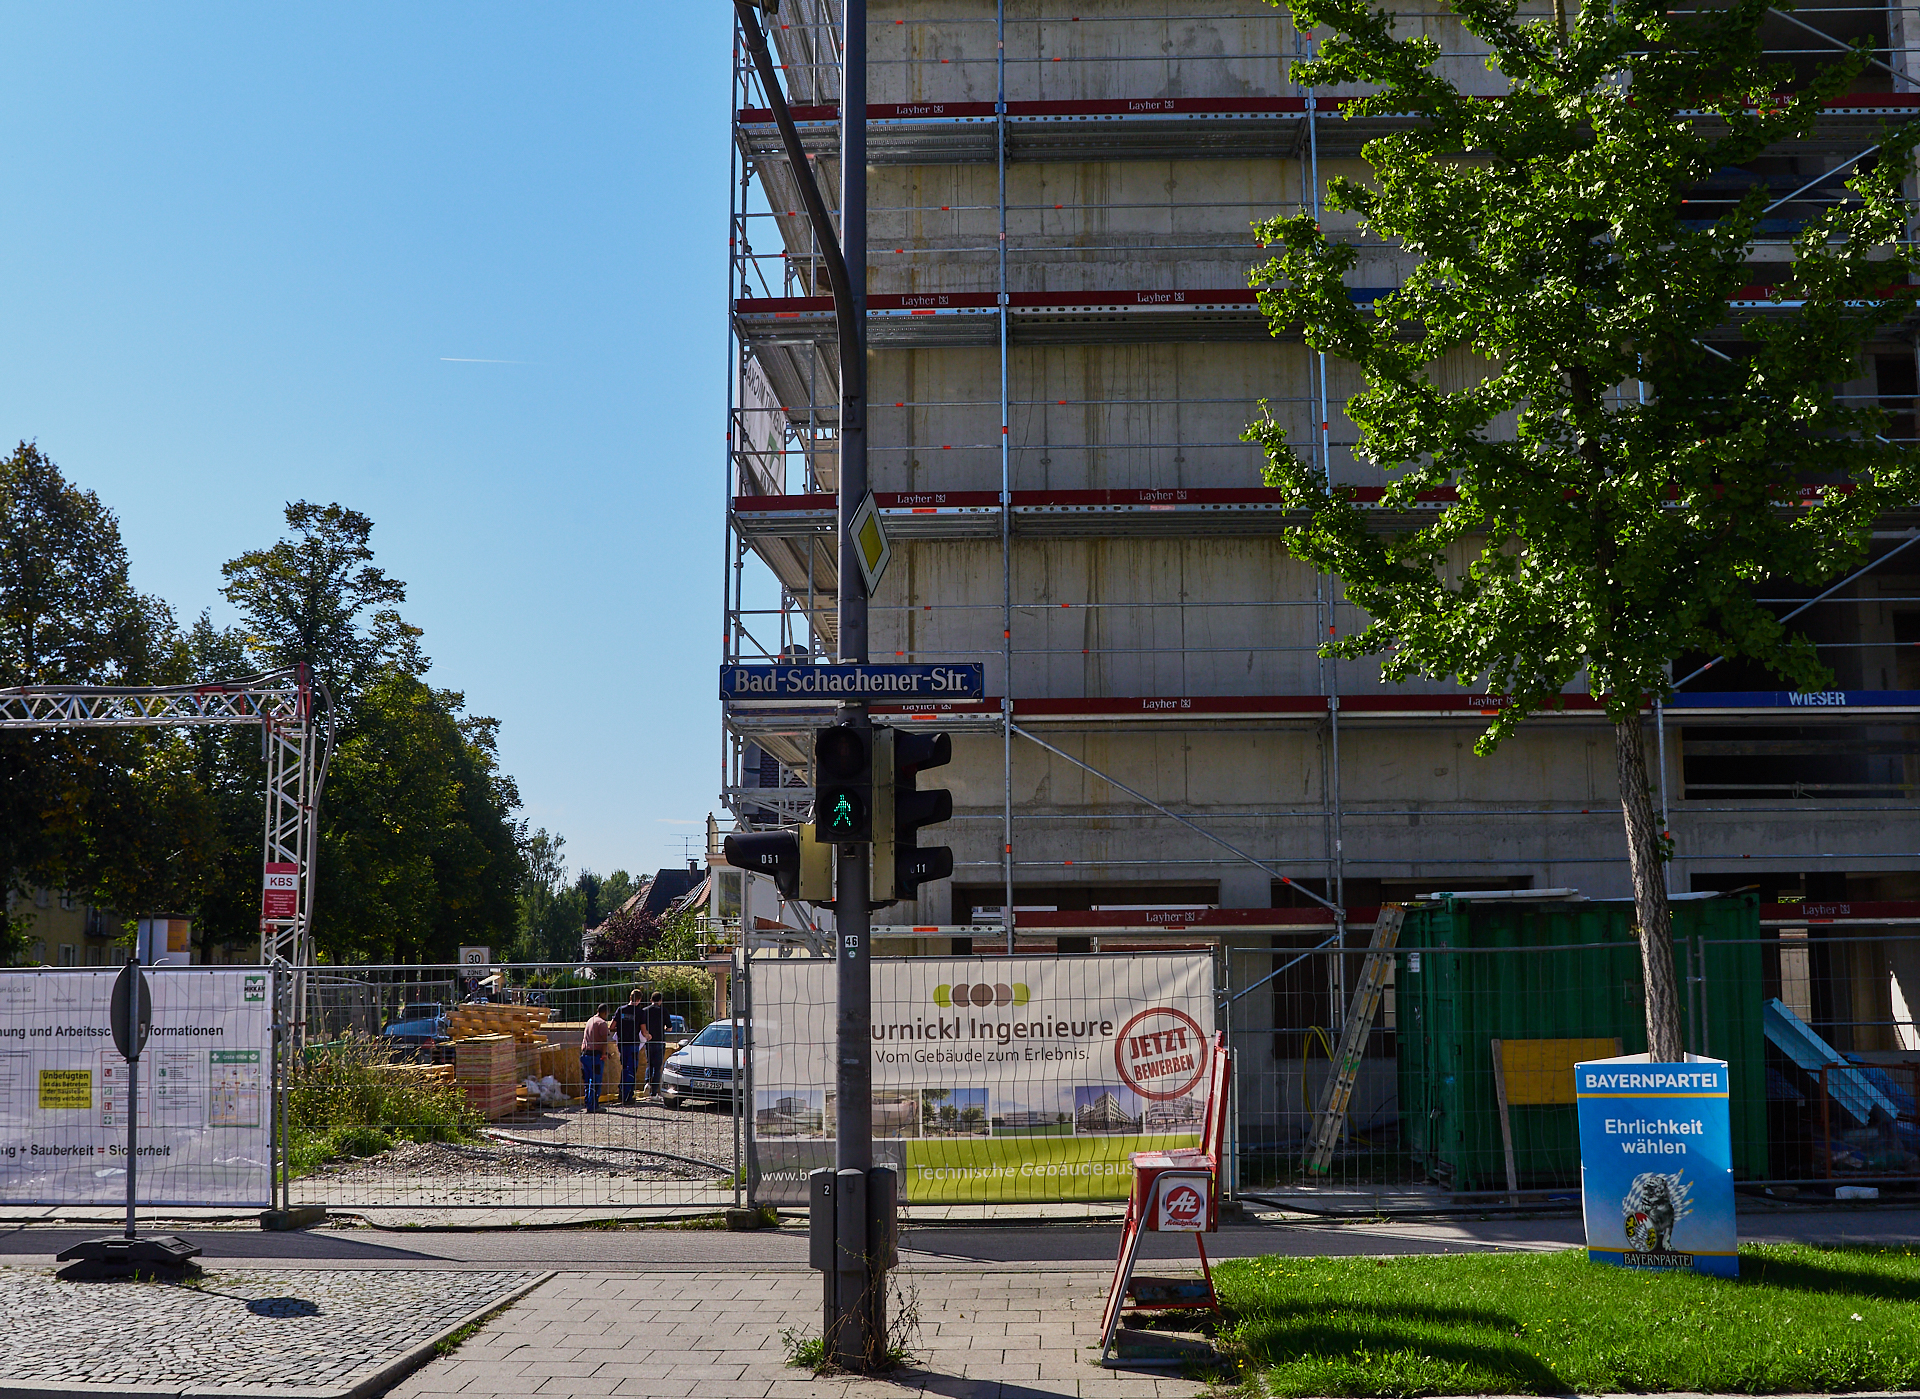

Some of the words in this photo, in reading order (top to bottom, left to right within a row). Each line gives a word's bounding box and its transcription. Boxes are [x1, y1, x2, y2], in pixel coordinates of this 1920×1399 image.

[896, 103, 930, 116] Layher
[1128, 99, 1161, 111] Layher
[901, 294, 935, 307] Layher
[1137, 292, 1171, 304] Layher
[897, 492, 932, 504] Layher
[1140, 490, 1173, 502] Layher
[734, 667, 968, 693] Bad-Schachener-Str.
[1142, 699, 1177, 710] Layher
[1468, 696, 1503, 707] Layher
[1788, 691, 1846, 706] WIESER
[761, 854, 779, 864] 051
[270, 877, 293, 887] KBS
[1146, 911, 1181, 923] Layher
[1802, 904, 1837, 917] Layher
[846, 937, 857, 947] 46
[468, 954, 481, 964] 30
[30, 1026, 52, 1037] und
[872, 1016, 960, 1040] urnickl
[971, 1015, 1113, 1045] Ingenieure
[1130, 1027, 1187, 1059] JETZT
[875, 1050, 910, 1063] Vom
[915, 1048, 983, 1063] Gebäude
[987, 1051, 1019, 1062] zum
[1025, 1047, 1089, 1061] Erlebnis.
[1134, 1054, 1195, 1081] BEWERBEN
[43, 1072, 89, 1081] Unbefugten
[1585, 1073, 1718, 1088] BAYERNPARTEI
[1605, 1119, 1703, 1134] Ehrlichkeit
[0, 1146, 16, 1158] ng
[31, 1143, 94, 1156] Sauberkeit
[109, 1143, 171, 1156] Sicerheit
[1621, 1138, 1687, 1154] wählen
[914, 1162, 1015, 1181] Technische
[824, 1185, 830, 1195] 2
[1624, 1253, 1693, 1267] BAYERNPARTEI
